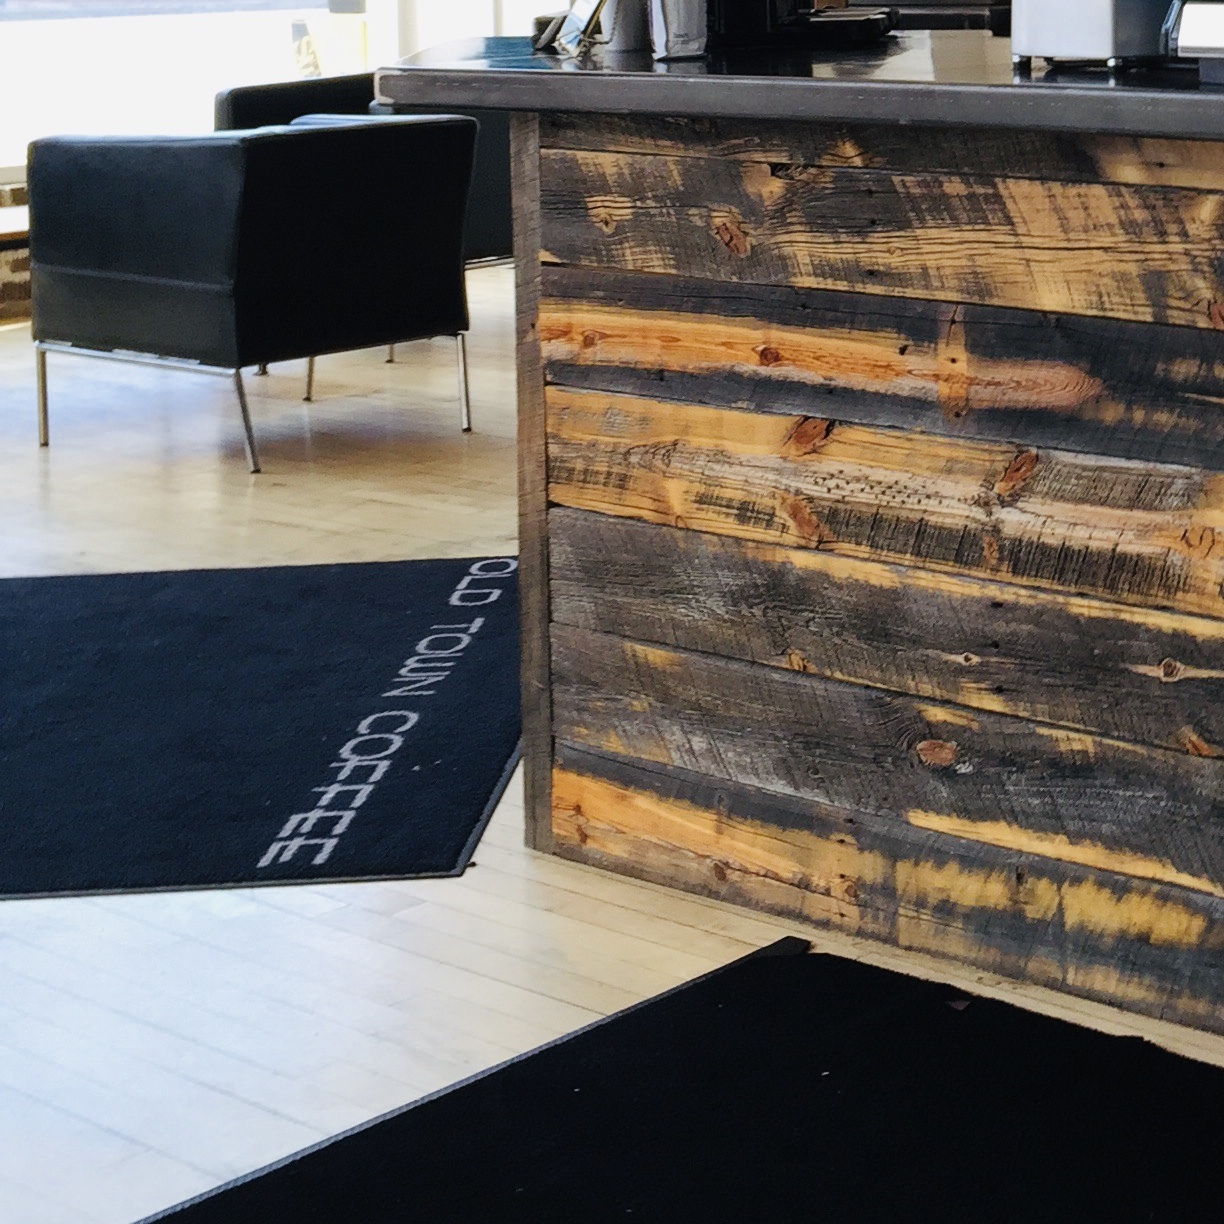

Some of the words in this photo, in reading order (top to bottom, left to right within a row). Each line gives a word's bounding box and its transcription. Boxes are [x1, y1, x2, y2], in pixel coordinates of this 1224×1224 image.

[449, 558, 519, 606] OLD
[380, 617, 485, 698] TOWN
[256, 710, 420, 868] COFFEE
